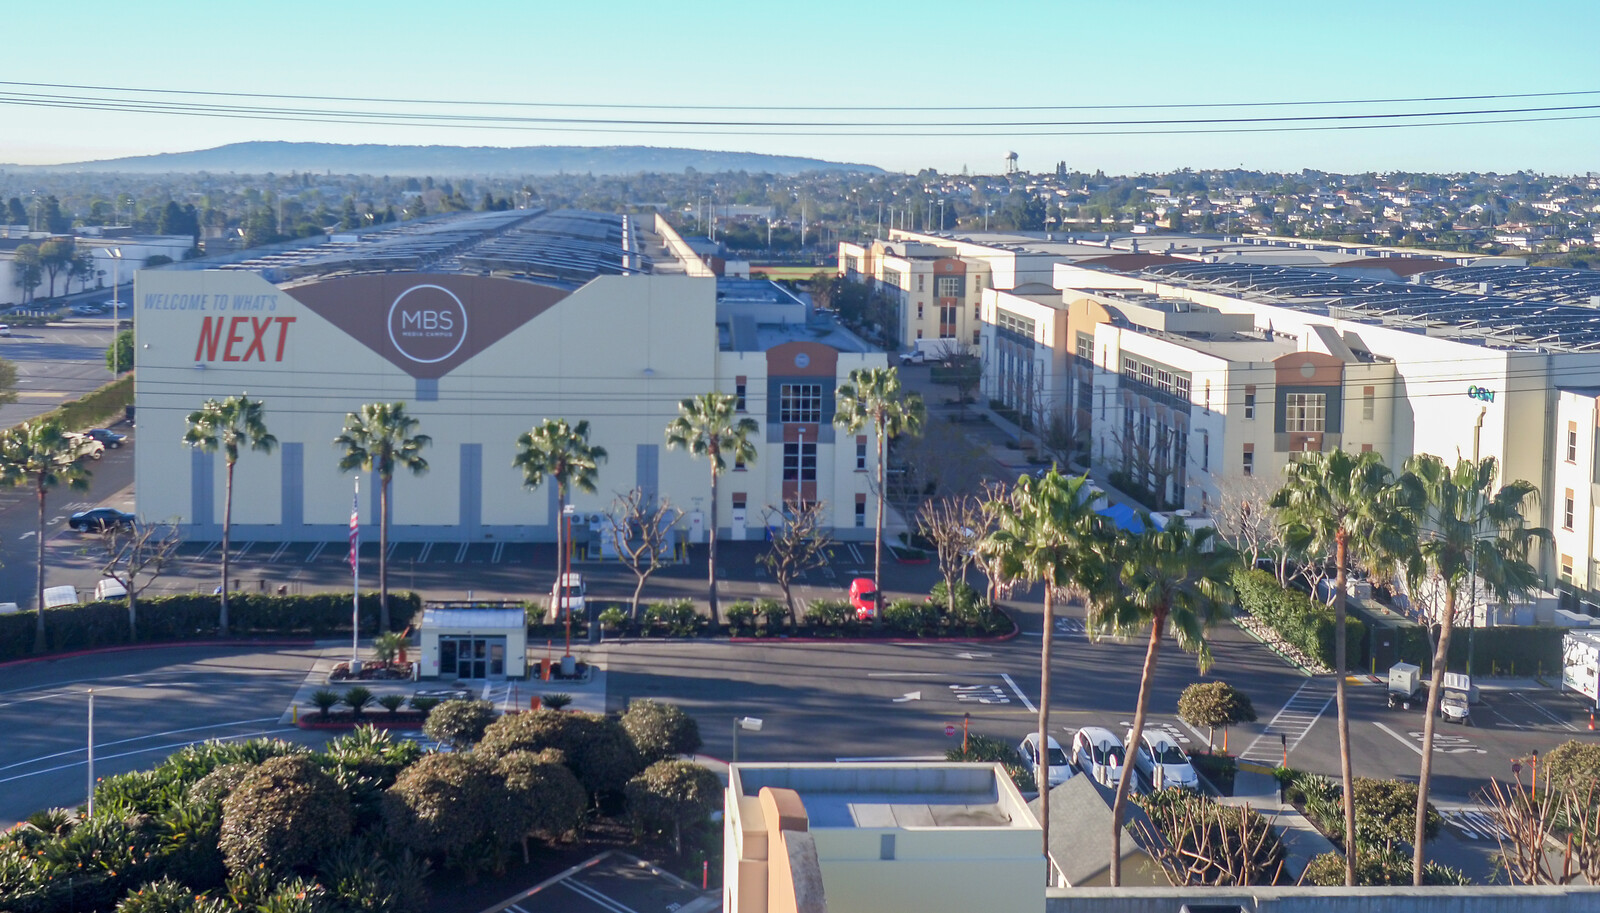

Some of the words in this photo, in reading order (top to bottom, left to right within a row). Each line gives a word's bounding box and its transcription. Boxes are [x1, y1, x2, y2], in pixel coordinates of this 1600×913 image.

[144, 293, 208, 310] WELCOME
[213, 294, 229, 311] TO
[232, 294, 278, 311] WHAT'S
[402, 310, 454, 330] MBS
[194, 316, 297, 362] NEXT
